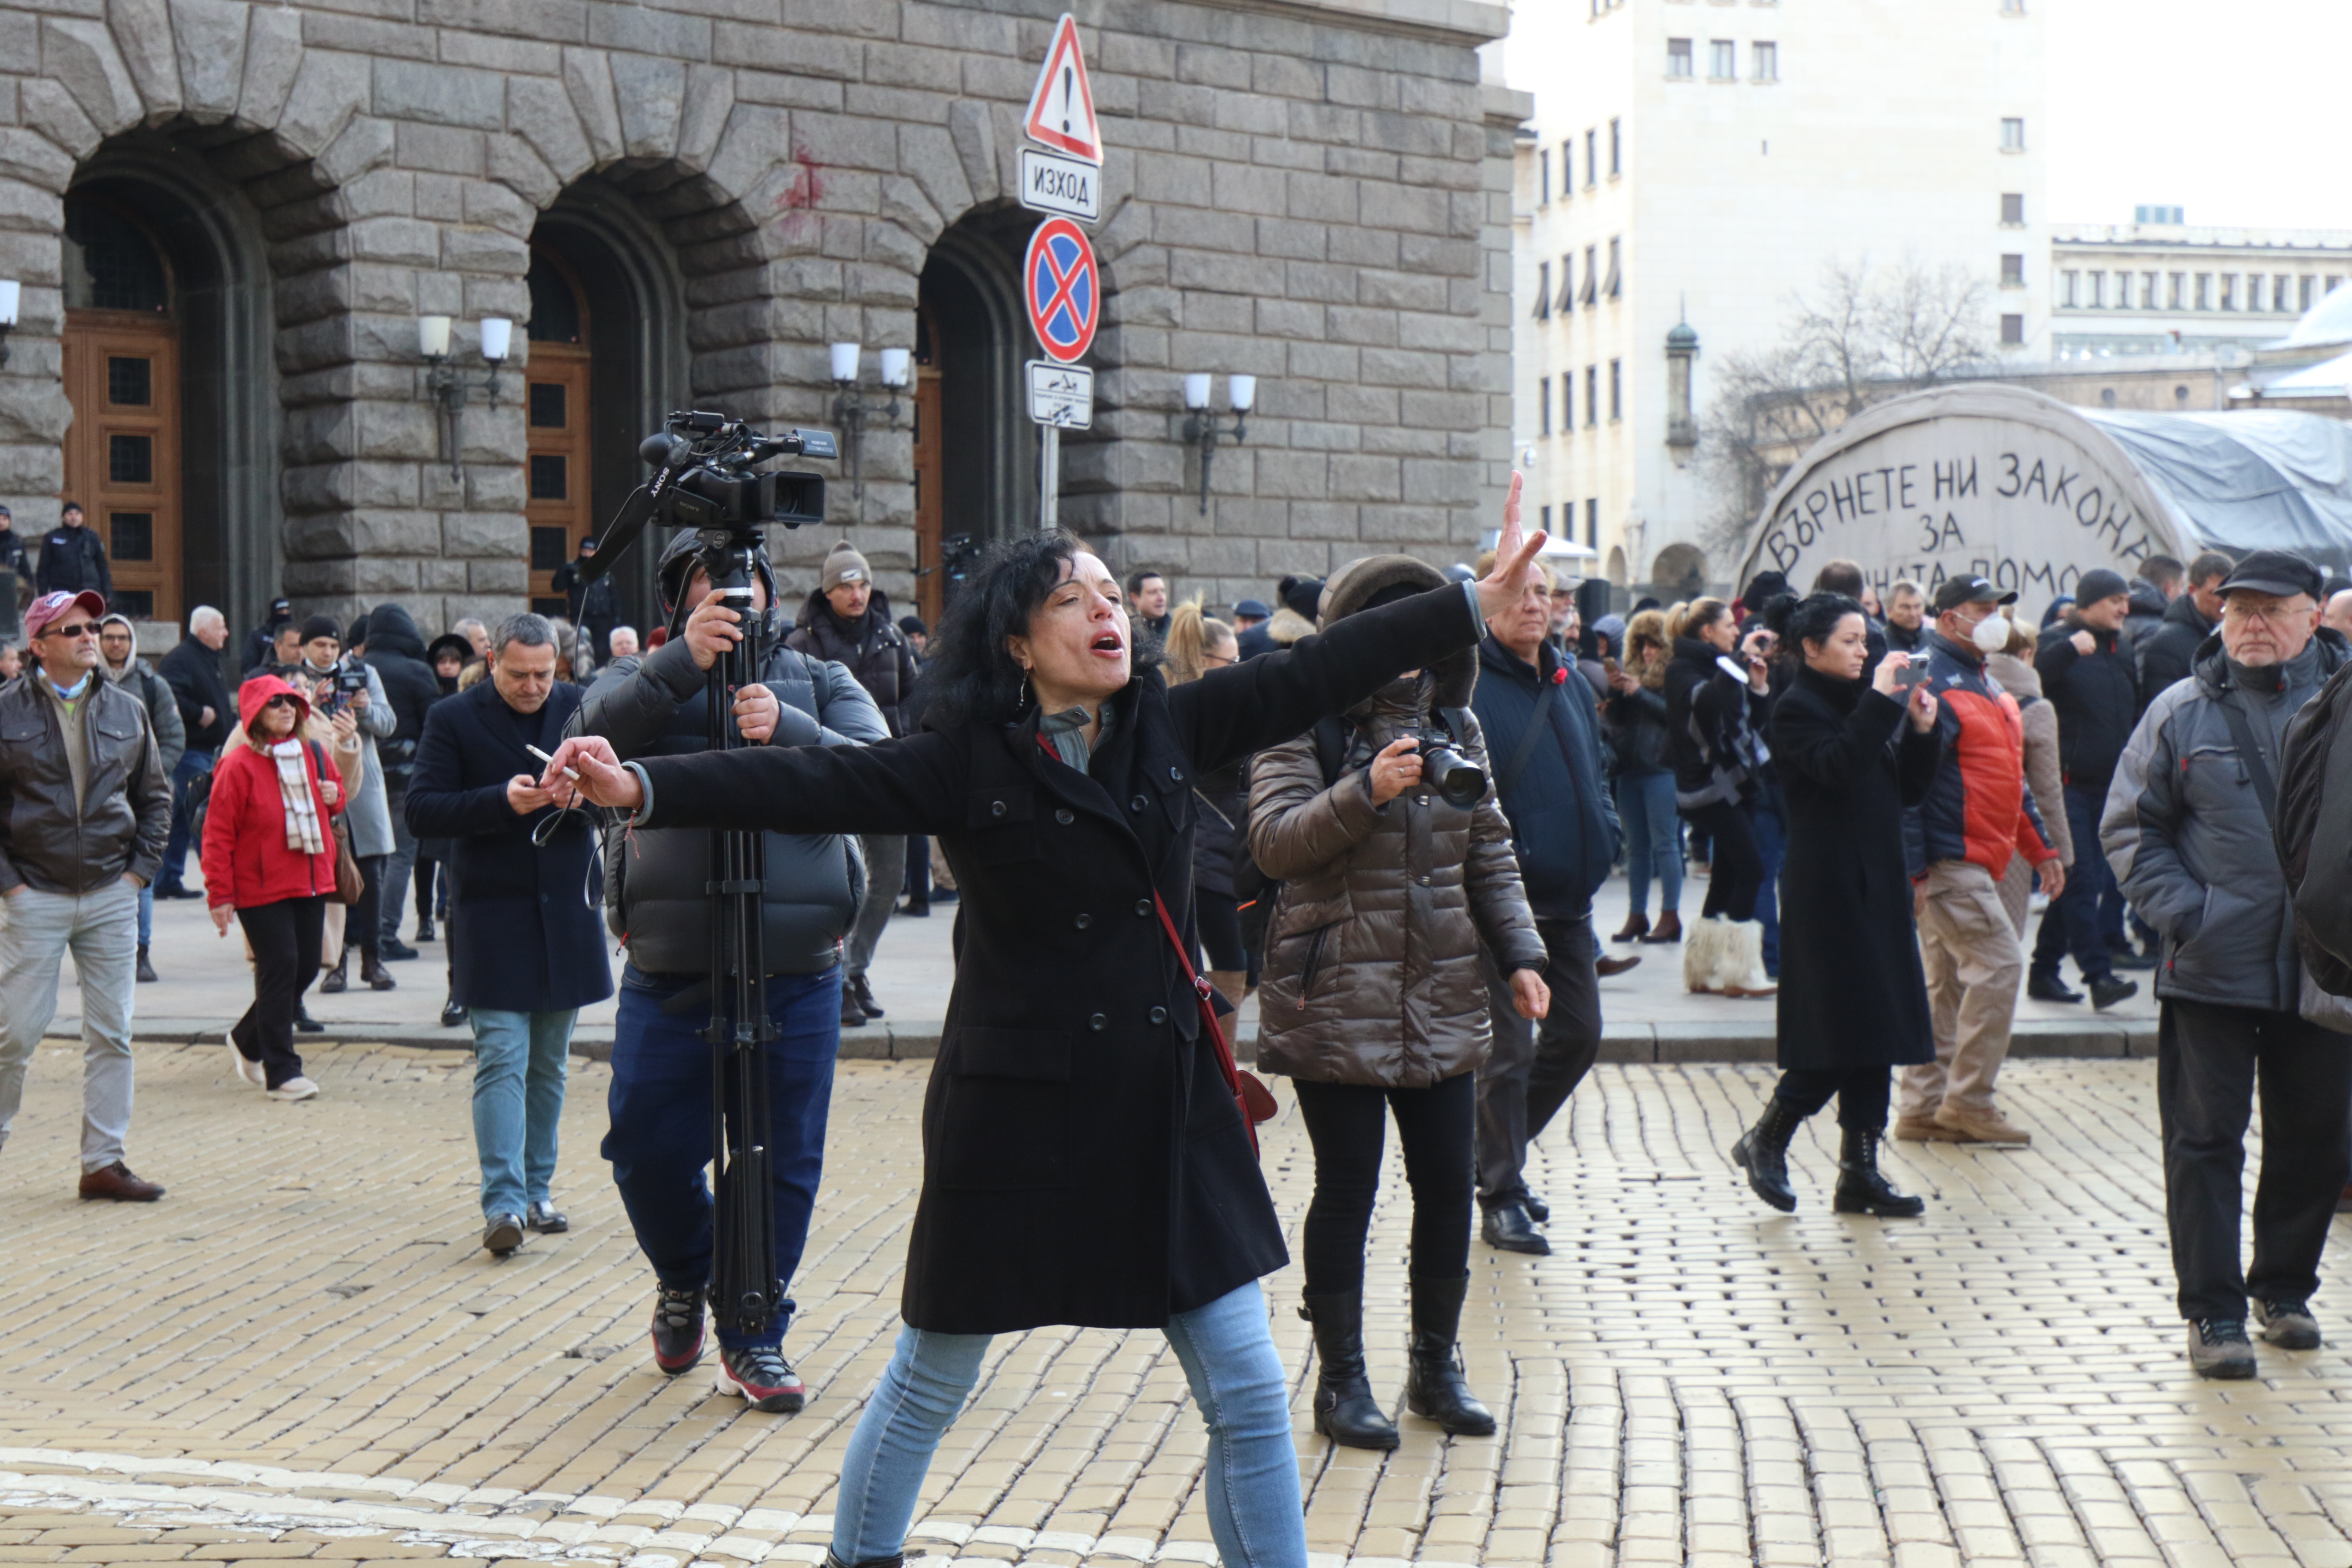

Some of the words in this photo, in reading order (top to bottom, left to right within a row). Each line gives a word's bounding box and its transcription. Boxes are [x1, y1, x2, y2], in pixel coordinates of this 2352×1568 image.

[1035, 165, 1089, 206] ИЗХОД
[650, 466, 670, 498] SONY
[679, 501, 700, 512] SONY
[1767, 465, 1917, 576] ВЪРНЕТЕ
[1934, 456, 1978, 501] НИ
[1997, 452, 2150, 560] ЗАКОНА
[1920, 511, 1965, 552] ЗА
